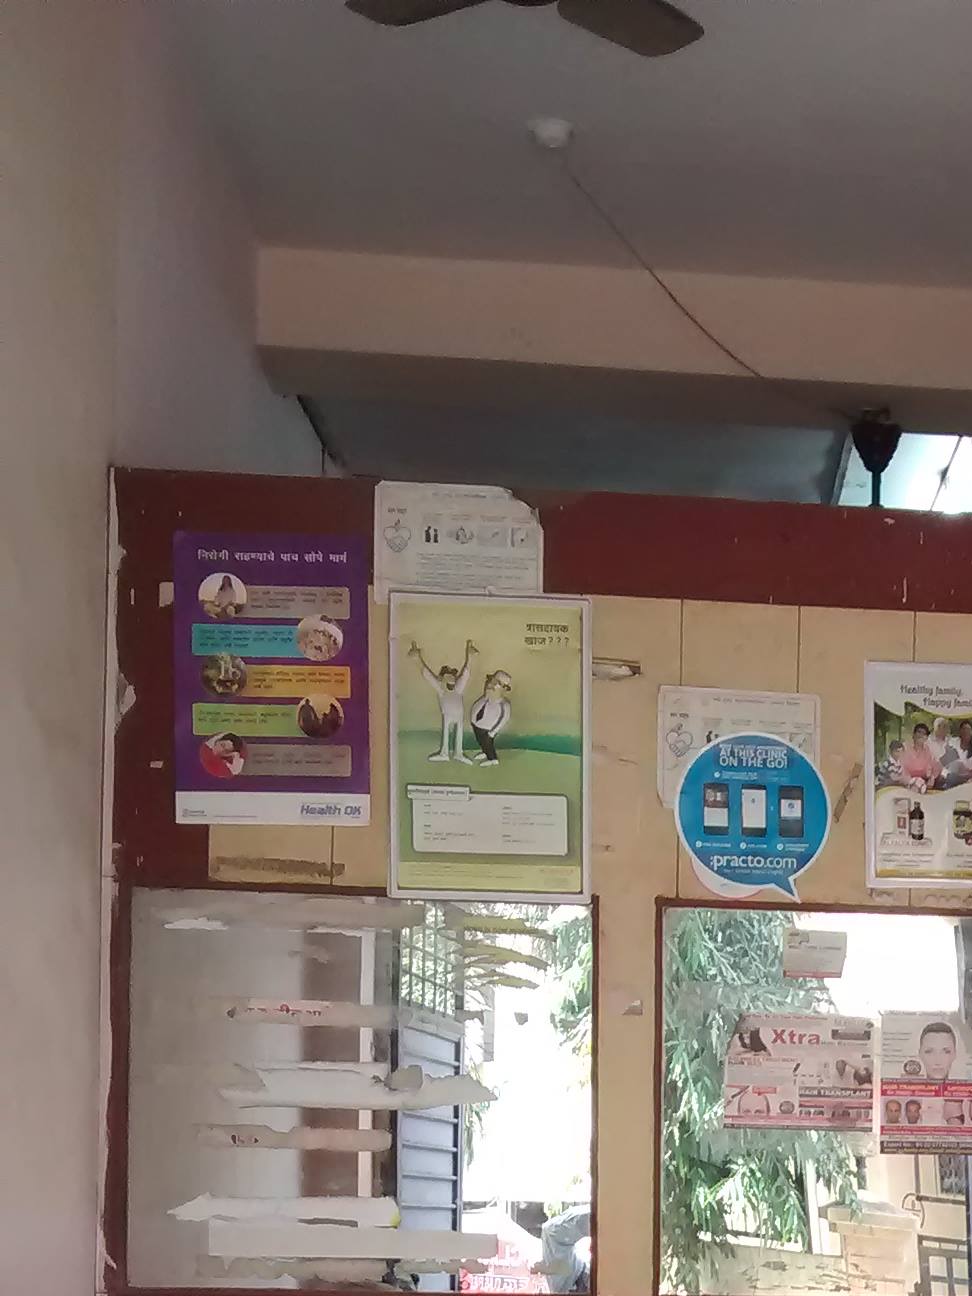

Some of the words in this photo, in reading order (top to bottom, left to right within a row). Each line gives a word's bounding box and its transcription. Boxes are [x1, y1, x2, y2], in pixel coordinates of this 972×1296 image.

[900, 684, 933, 696] Healthy
[923, 698, 951, 708] Happy
[734, 748, 754, 759] THIS
[756, 749, 788, 760] CLINIC
[719, 756, 738, 767] ON
[741, 757, 763, 768] THE
[766, 758, 788, 769] GO!
[300, 804, 341, 816] Health
[344, 805, 362, 816] OK
[771, 1029, 821, 1046] Xtra
[819, 1088, 872, 1097] TRANSPLANT
